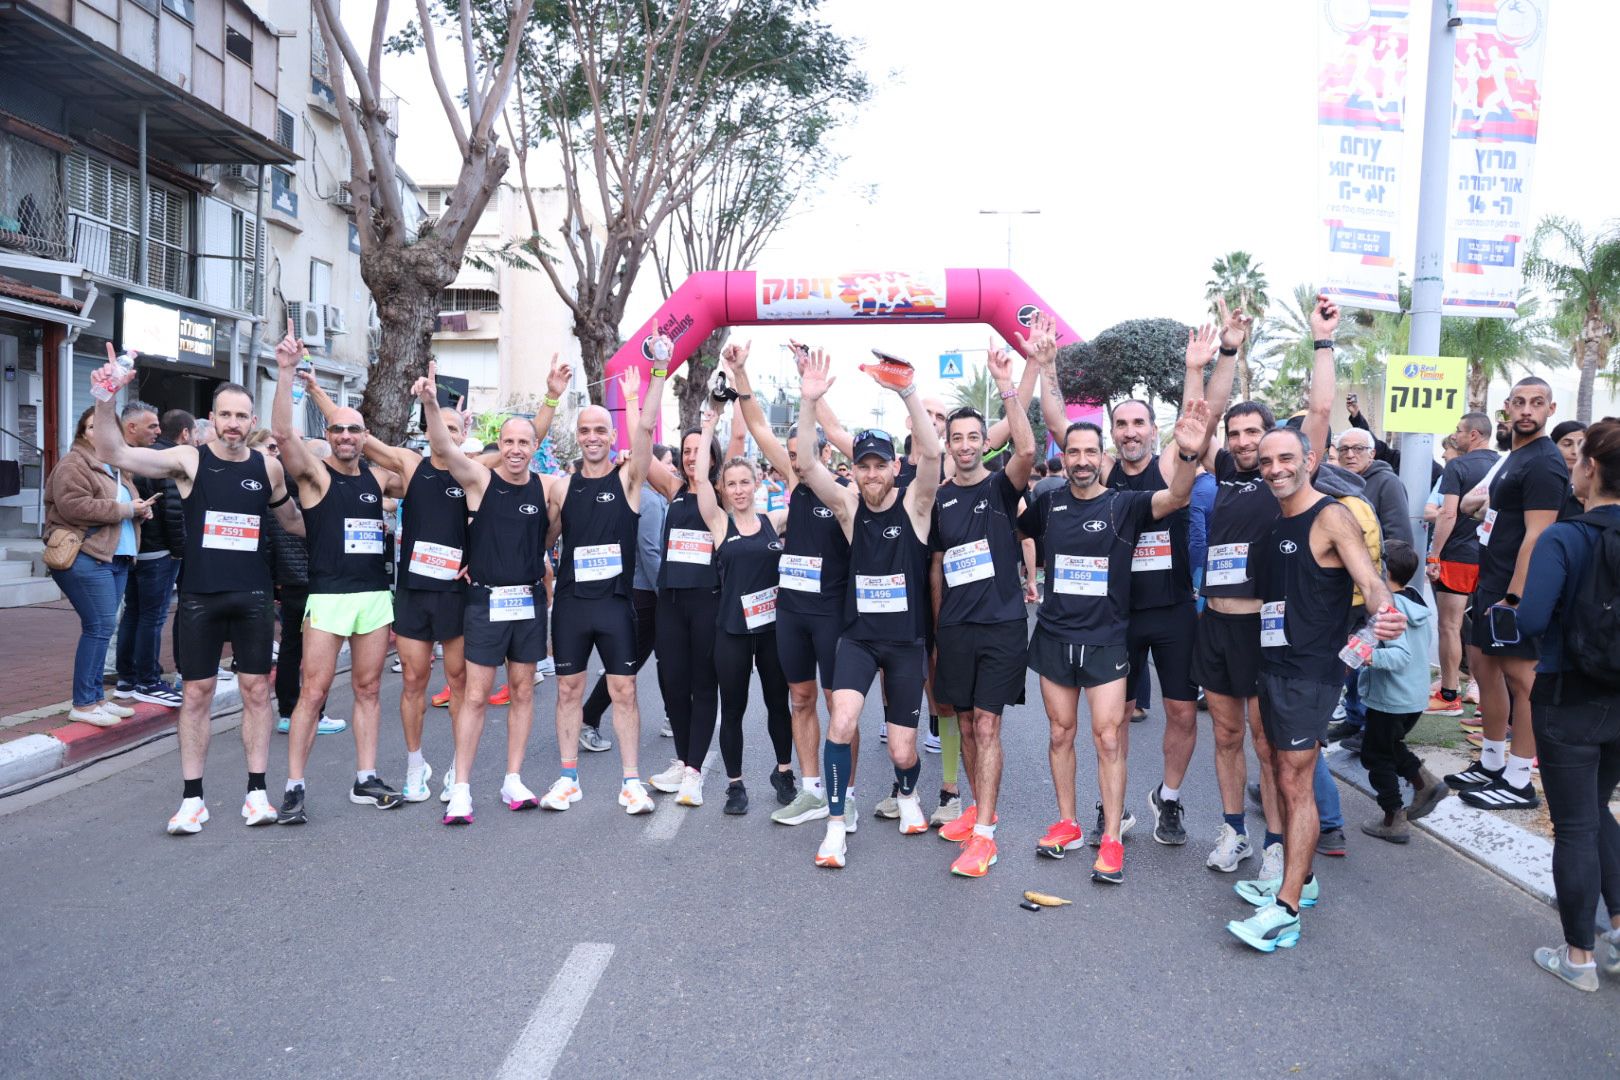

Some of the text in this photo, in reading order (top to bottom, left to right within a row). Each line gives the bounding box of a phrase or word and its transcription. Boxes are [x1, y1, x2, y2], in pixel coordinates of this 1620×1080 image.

[1475, 148, 1517, 173] מרוץ
[1458, 174, 1524, 194] אור יהודה
[762, 277, 833, 305] זינוק
[657, 312, 679, 336] Real
[666, 313, 695, 342] iming
[1420, 370, 1444, 381] Timing
[1390, 386, 1458, 413] זינוק
[221, 527, 244, 537] 2591
[1133, 548, 1156, 556] 2616
[588, 558, 608, 567] 1153
[955, 557, 977, 569] 1059
[1216, 559, 1233, 569] 1686
[1069, 570, 1092, 580] 1669
[869, 589, 892, 598] 1496
